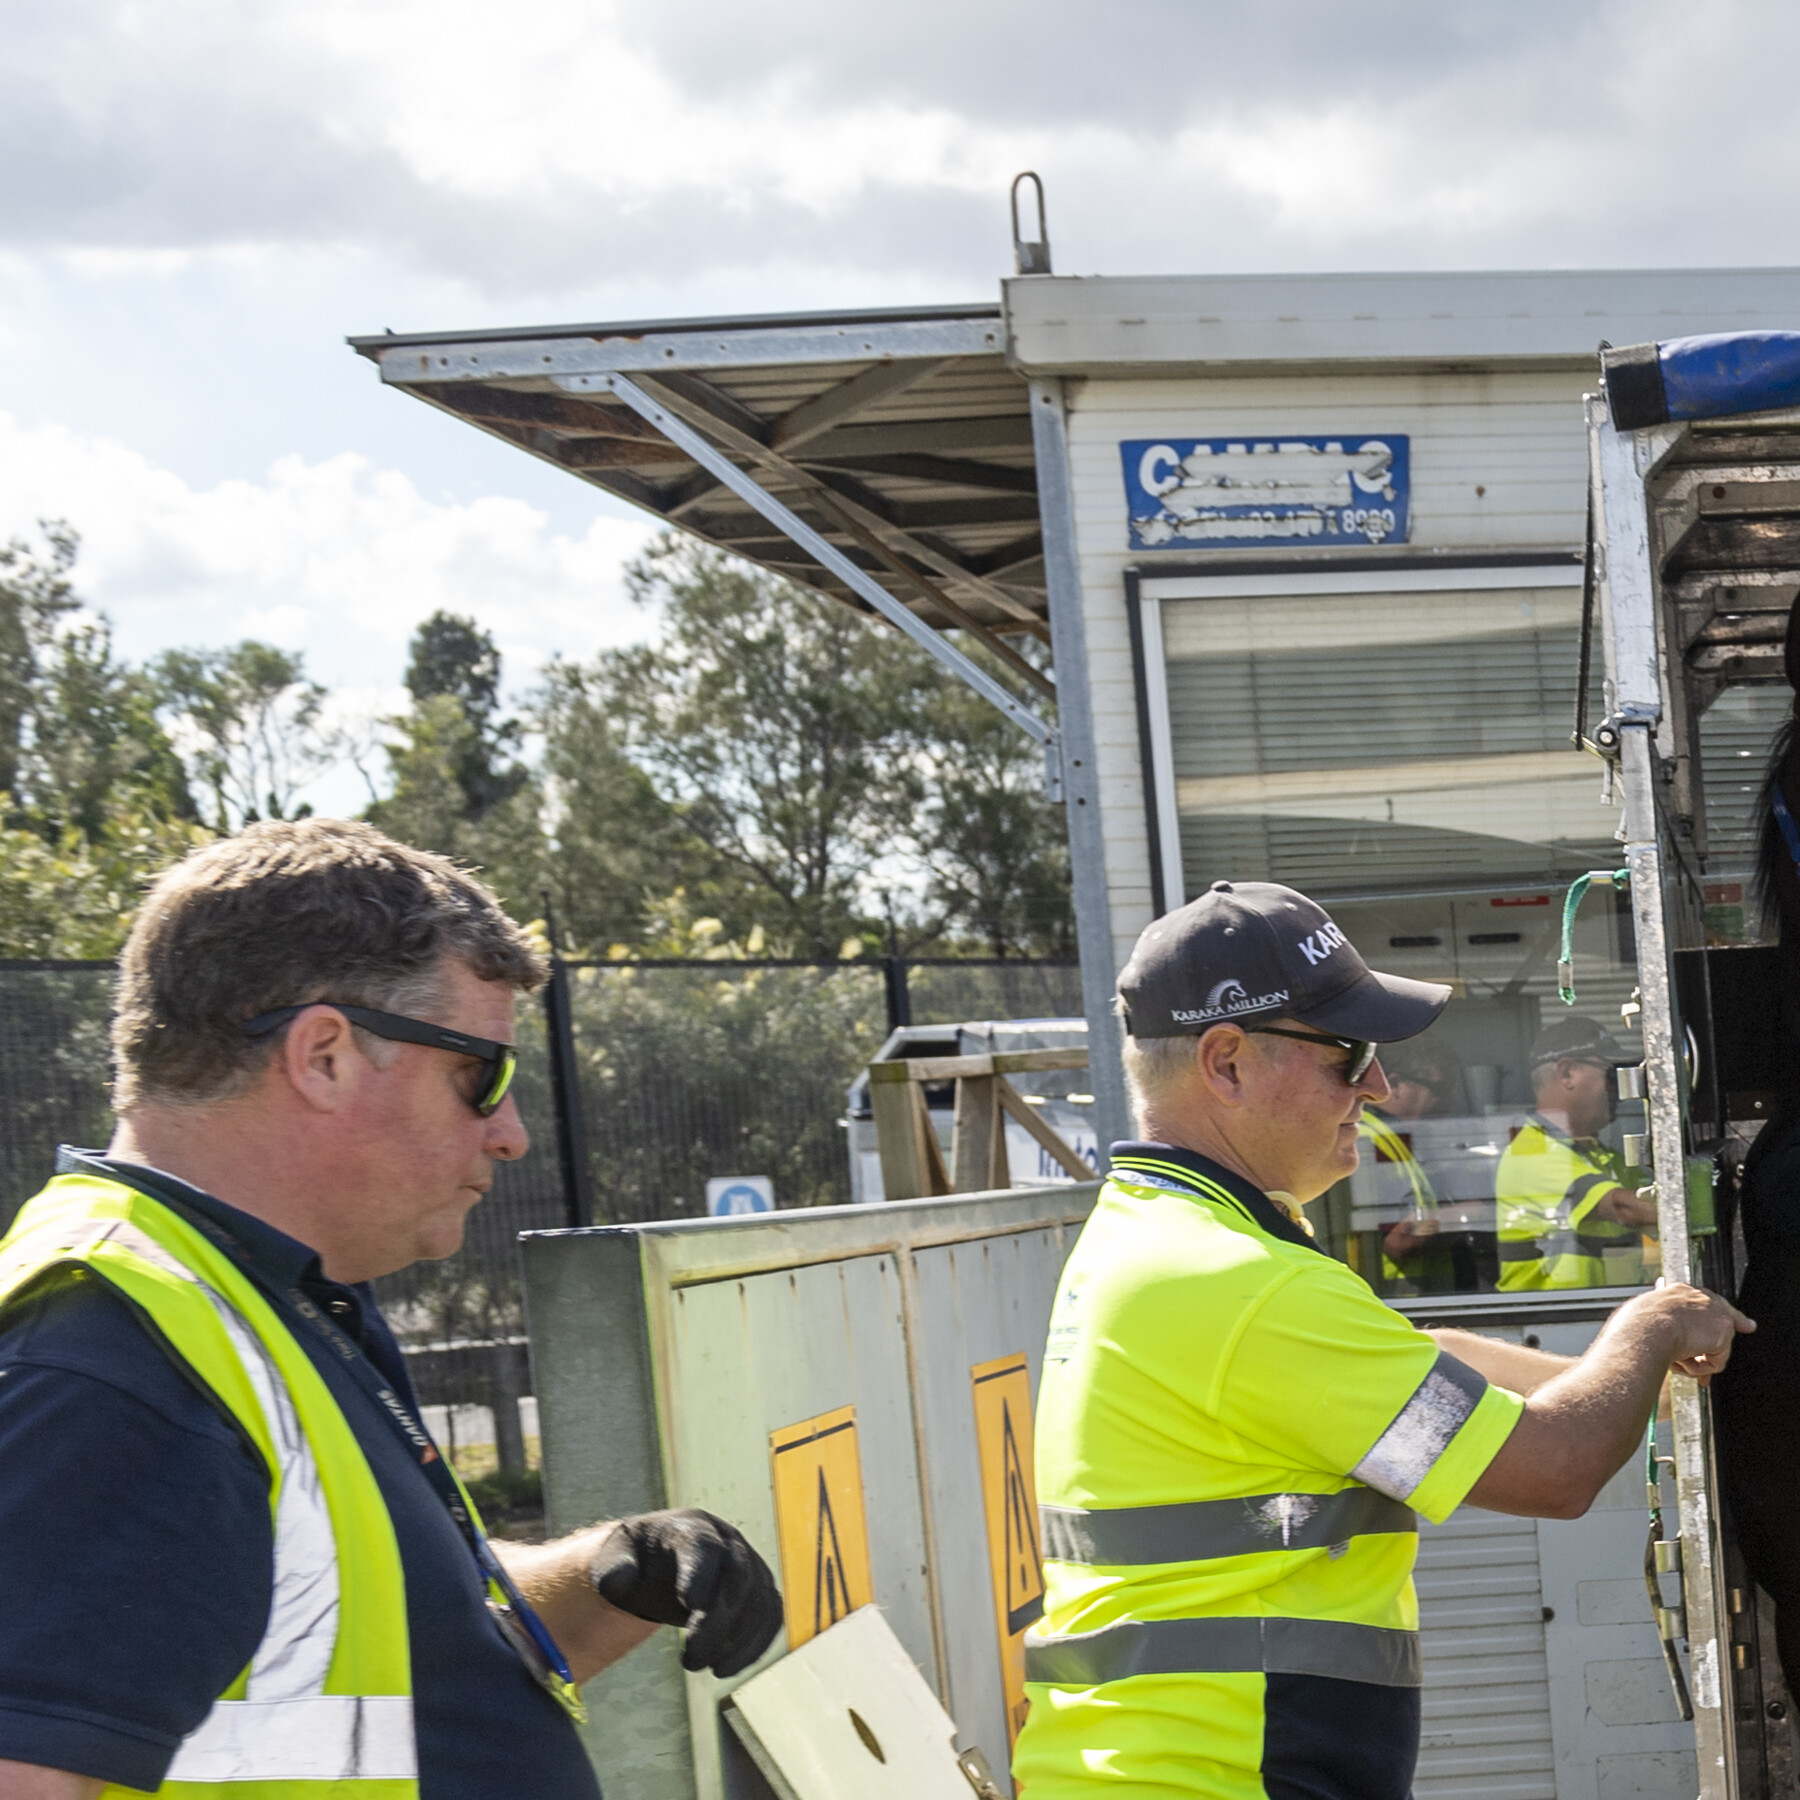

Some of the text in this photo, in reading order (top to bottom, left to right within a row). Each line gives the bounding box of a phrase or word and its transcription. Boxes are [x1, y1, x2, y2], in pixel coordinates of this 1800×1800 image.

[1170, 989, 1290, 1022] KARAKA MILLION
[376, 1389, 429, 1446] QANTAS
